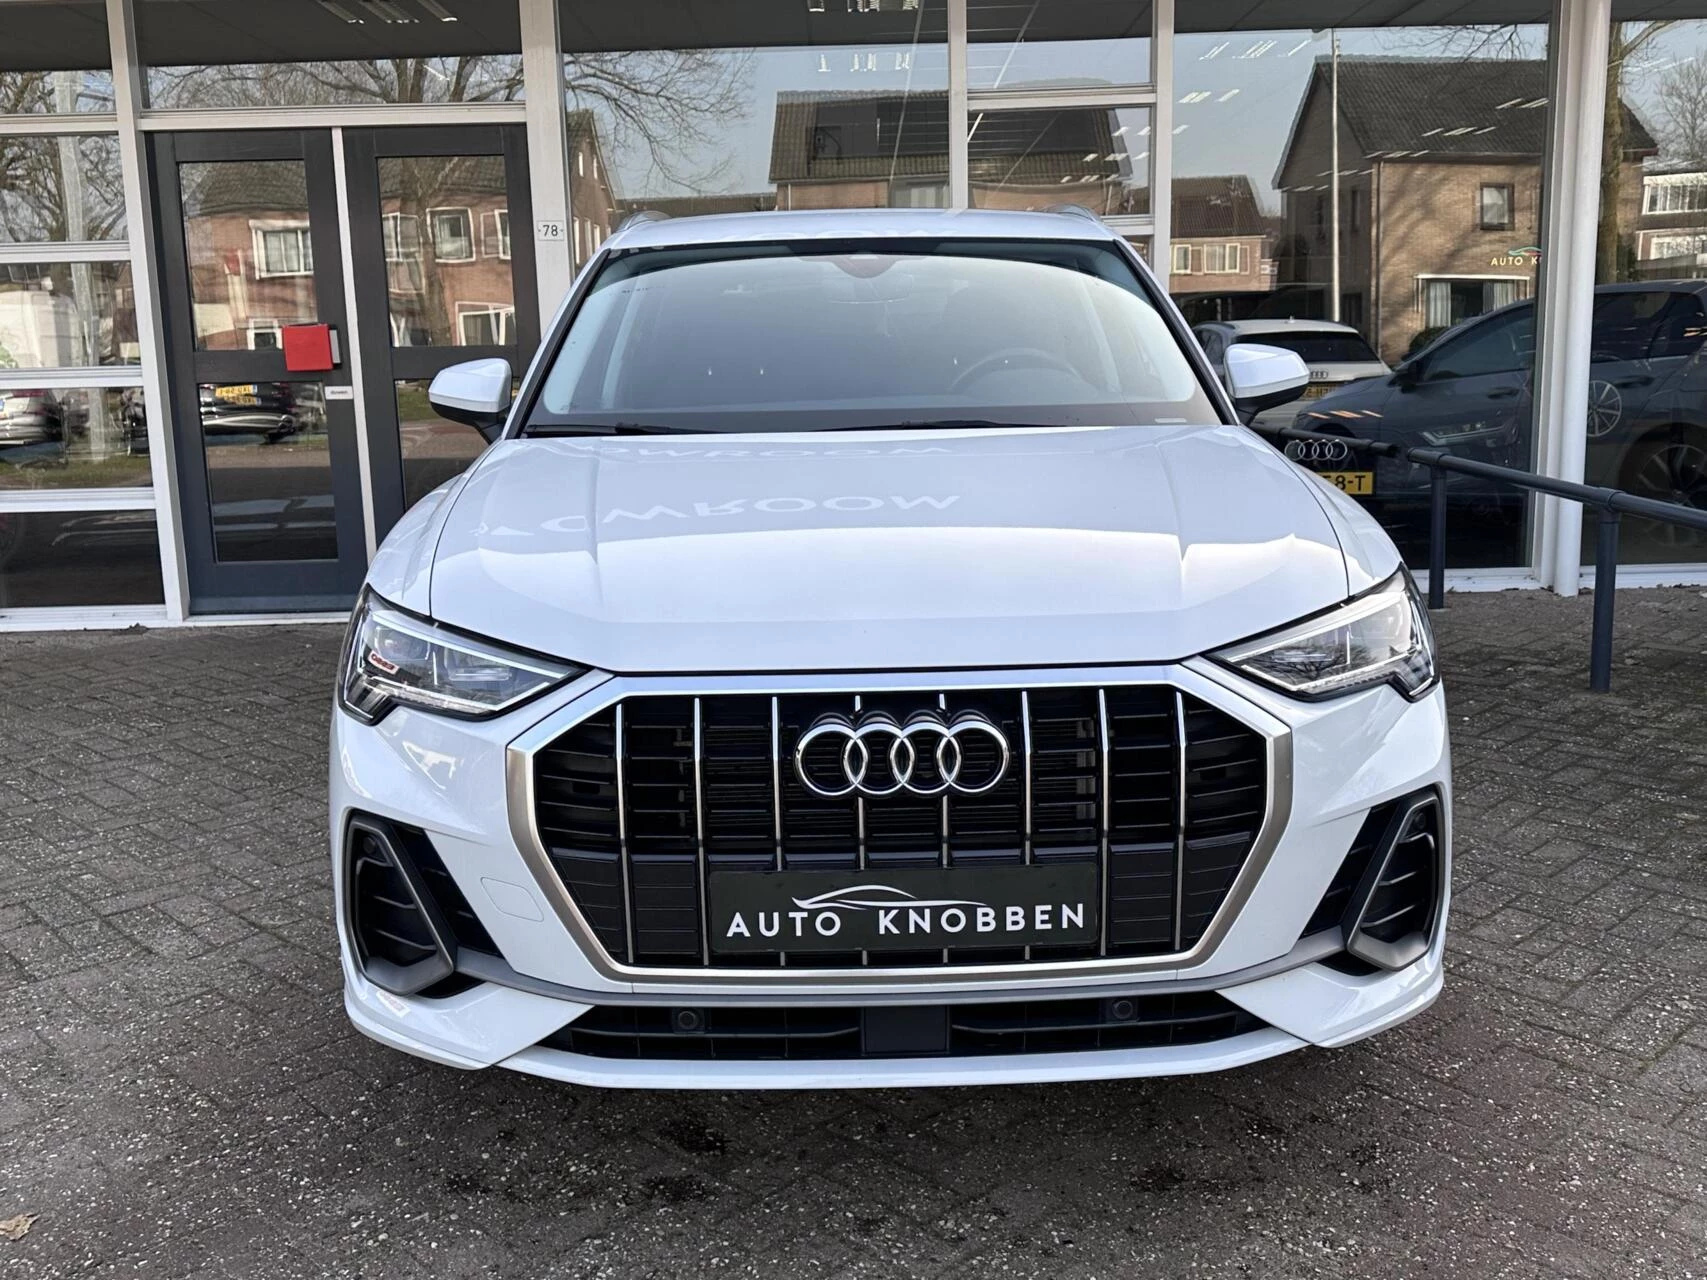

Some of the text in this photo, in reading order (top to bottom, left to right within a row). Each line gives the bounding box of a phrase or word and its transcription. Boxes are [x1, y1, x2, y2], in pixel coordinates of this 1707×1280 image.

[543, 224, 559, 237] 78
[1490, 256, 1523, 266] AUTO
[726, 903, 1084, 938] AUTO KNOBBEN
